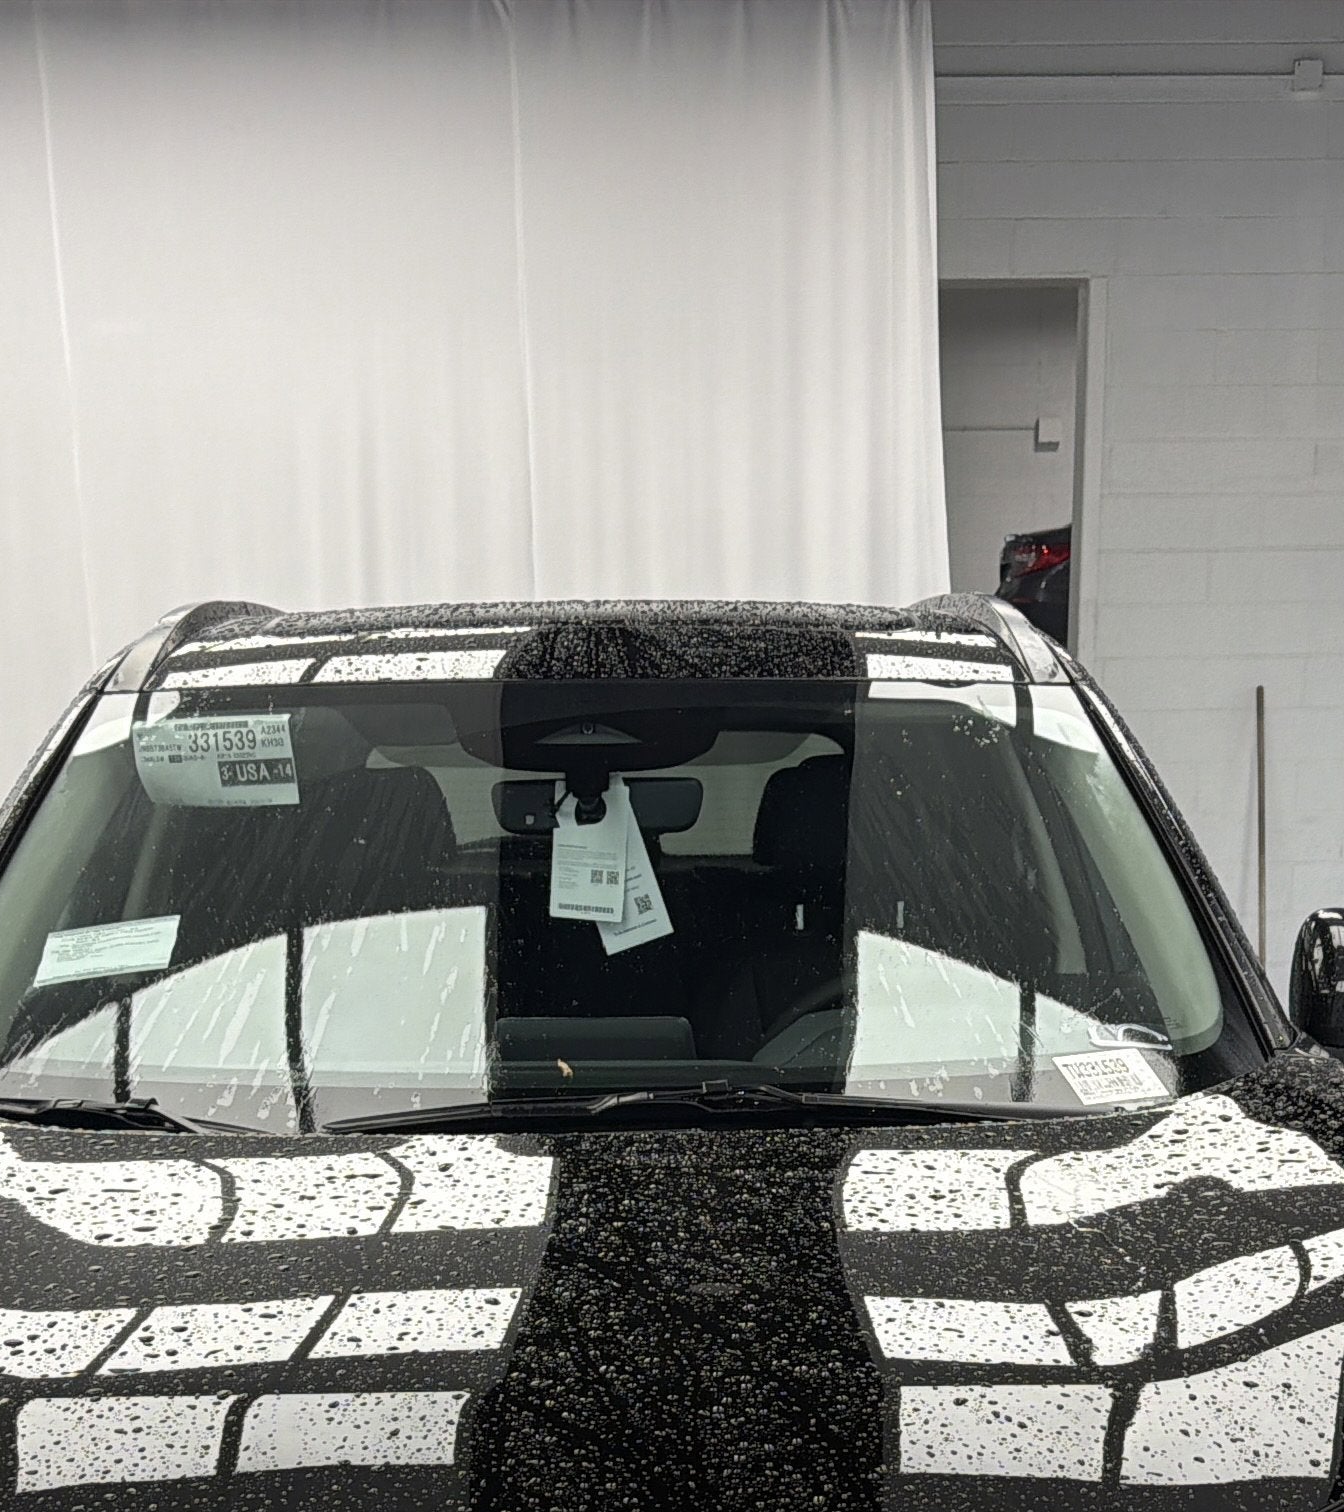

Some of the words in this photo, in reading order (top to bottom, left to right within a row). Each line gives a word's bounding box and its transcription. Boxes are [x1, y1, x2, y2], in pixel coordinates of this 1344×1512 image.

[188, 730, 257, 753] 331539
[236, 762, 271, 782] USA
[1061, 1057, 1130, 1080] TW331539
